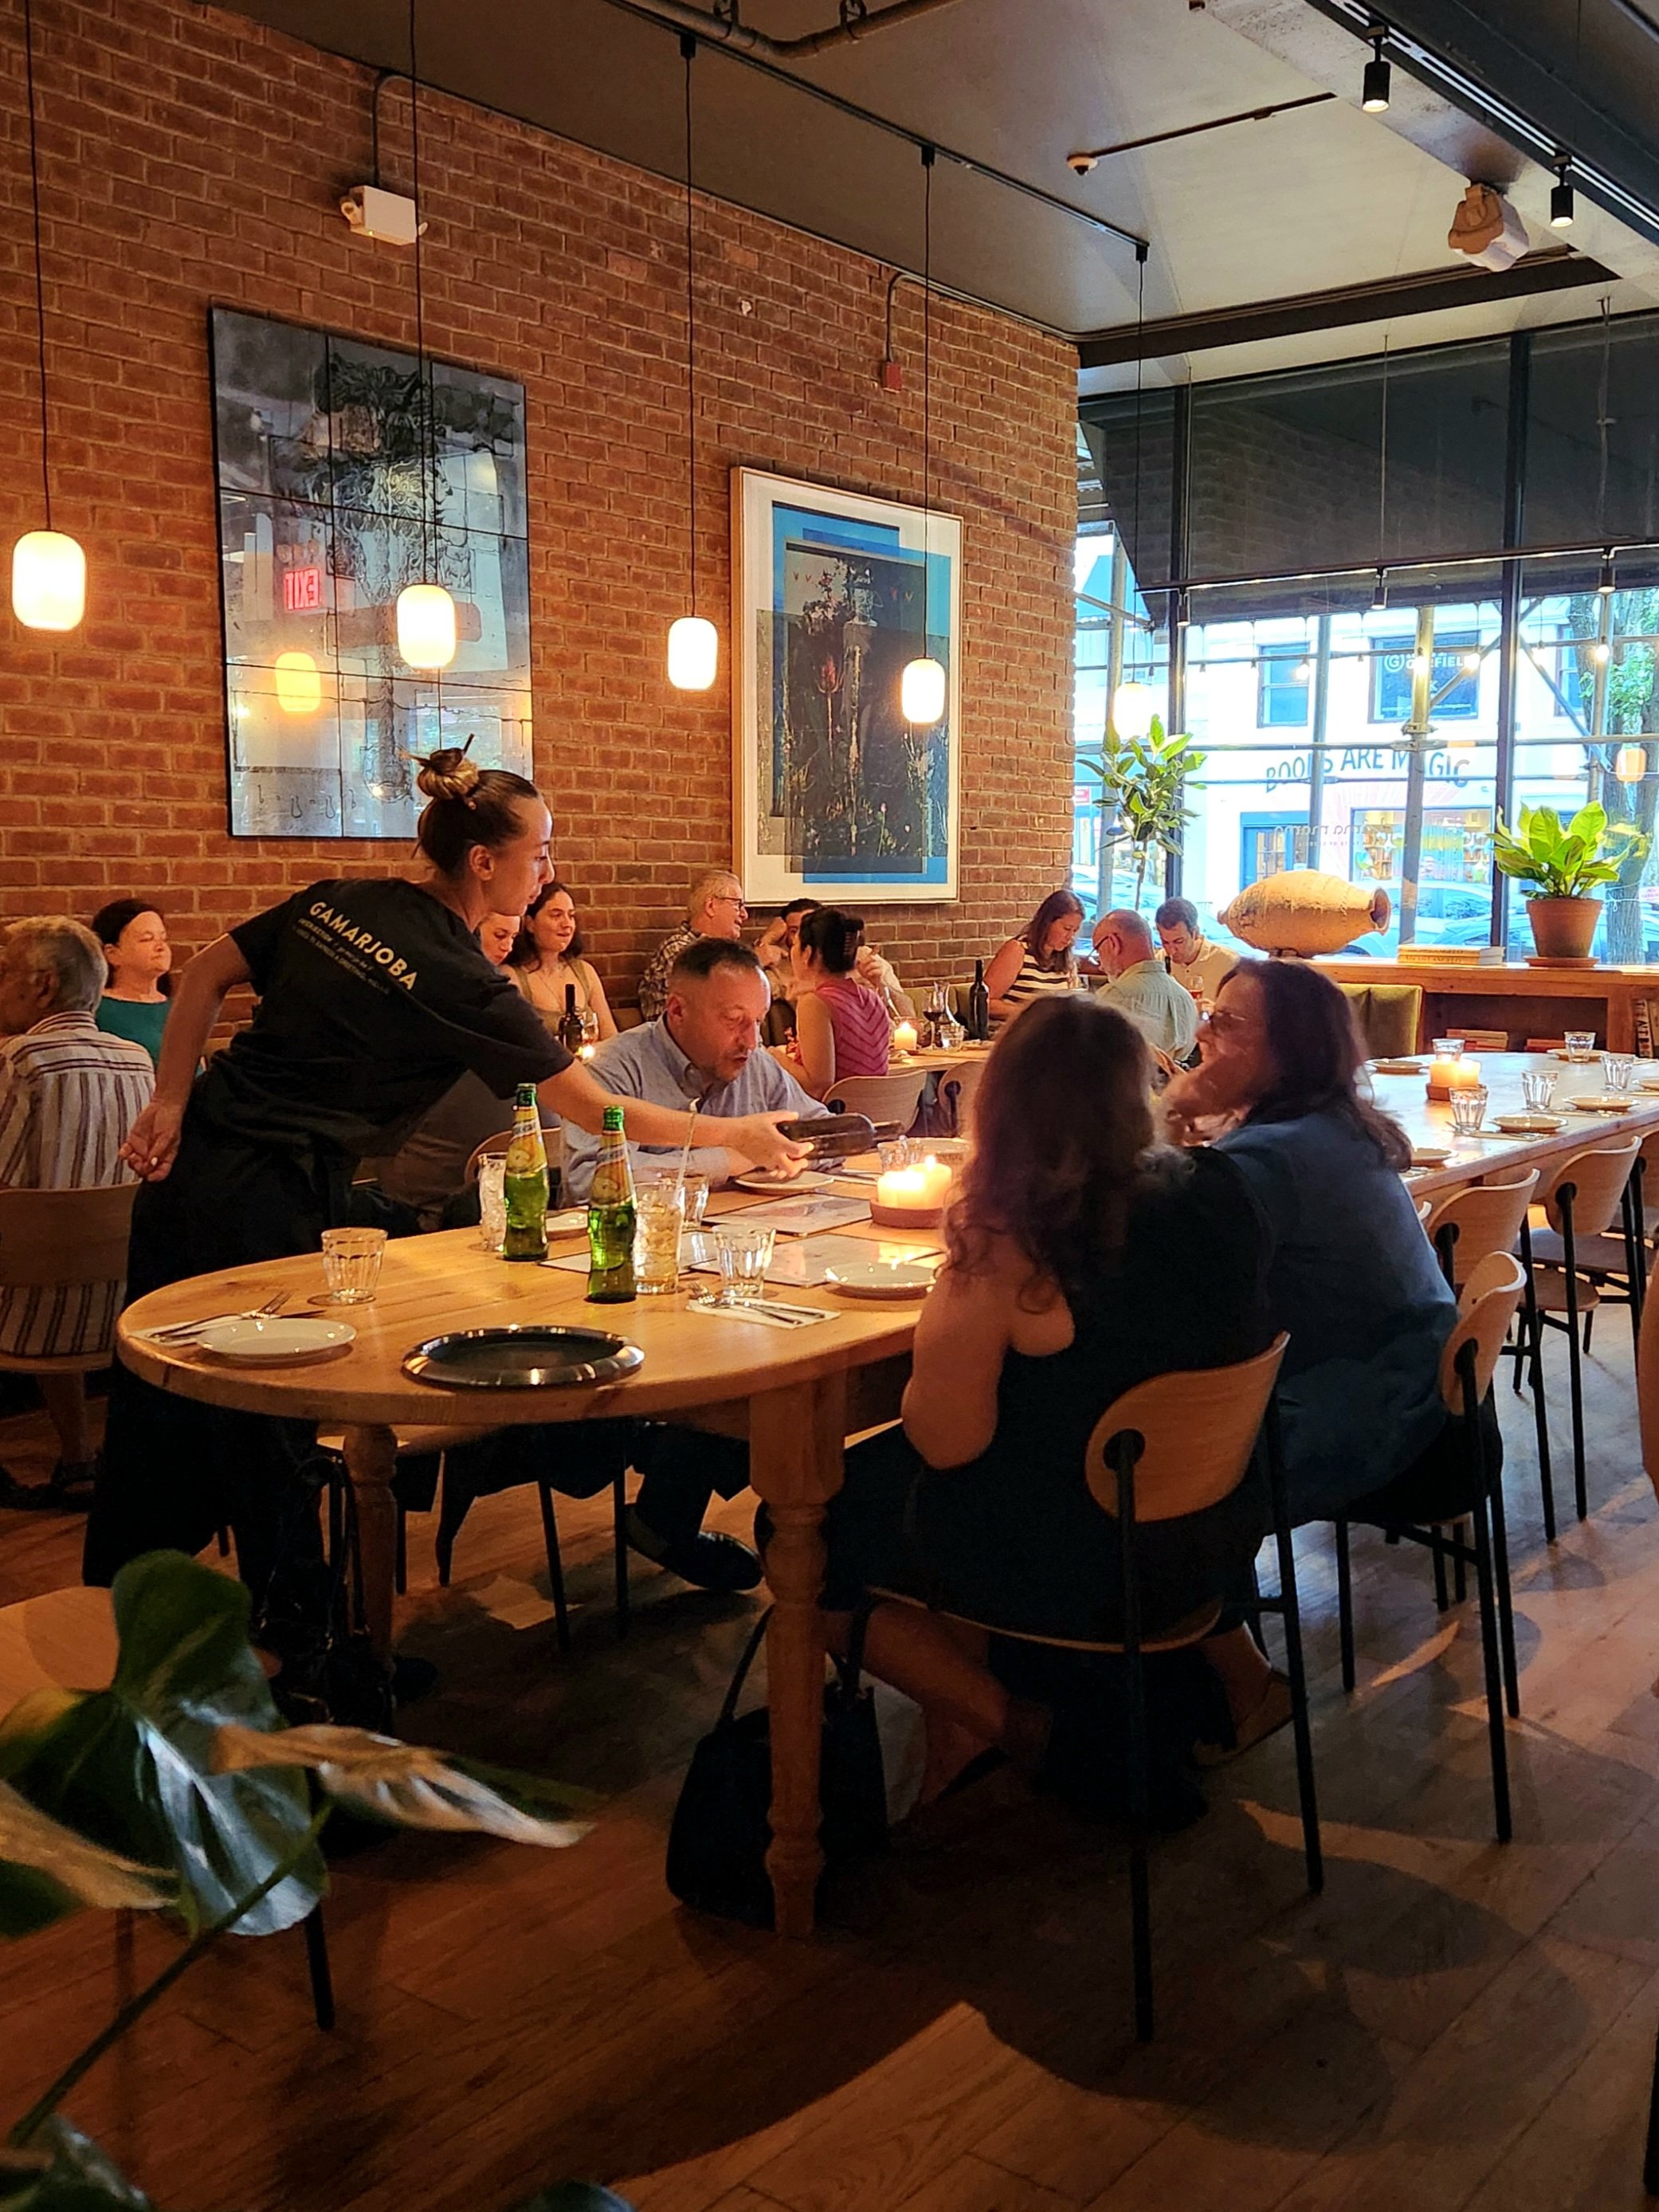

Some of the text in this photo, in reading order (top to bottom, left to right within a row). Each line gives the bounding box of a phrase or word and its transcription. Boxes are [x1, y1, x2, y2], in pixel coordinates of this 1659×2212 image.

[1340, 747, 1383, 771] ARE
[1391, 750, 1470, 788] MGIC
[309, 902, 418, 990] GAMARJOBA
